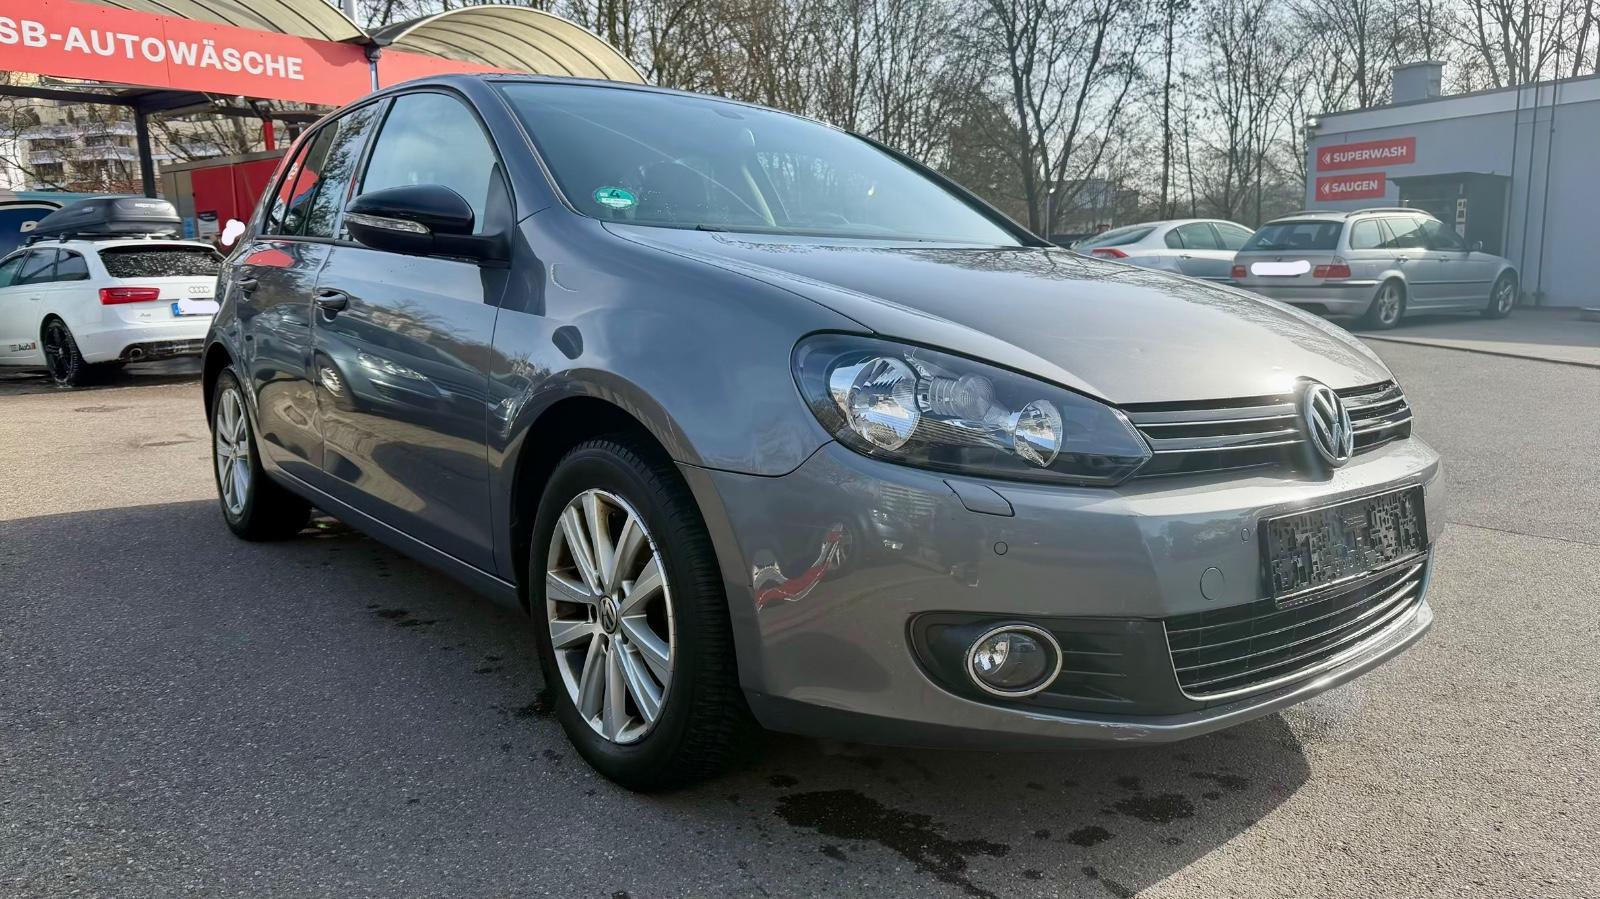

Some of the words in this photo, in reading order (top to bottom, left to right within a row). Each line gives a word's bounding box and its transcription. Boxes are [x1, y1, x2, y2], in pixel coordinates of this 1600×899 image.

[0, 16, 304, 80] SB-AUTOWÄSCHE
[1333, 147, 1406, 162] SUPERWASH
[1332, 180, 1377, 192] SAUGEN
[609, 190, 620, 198] 4
